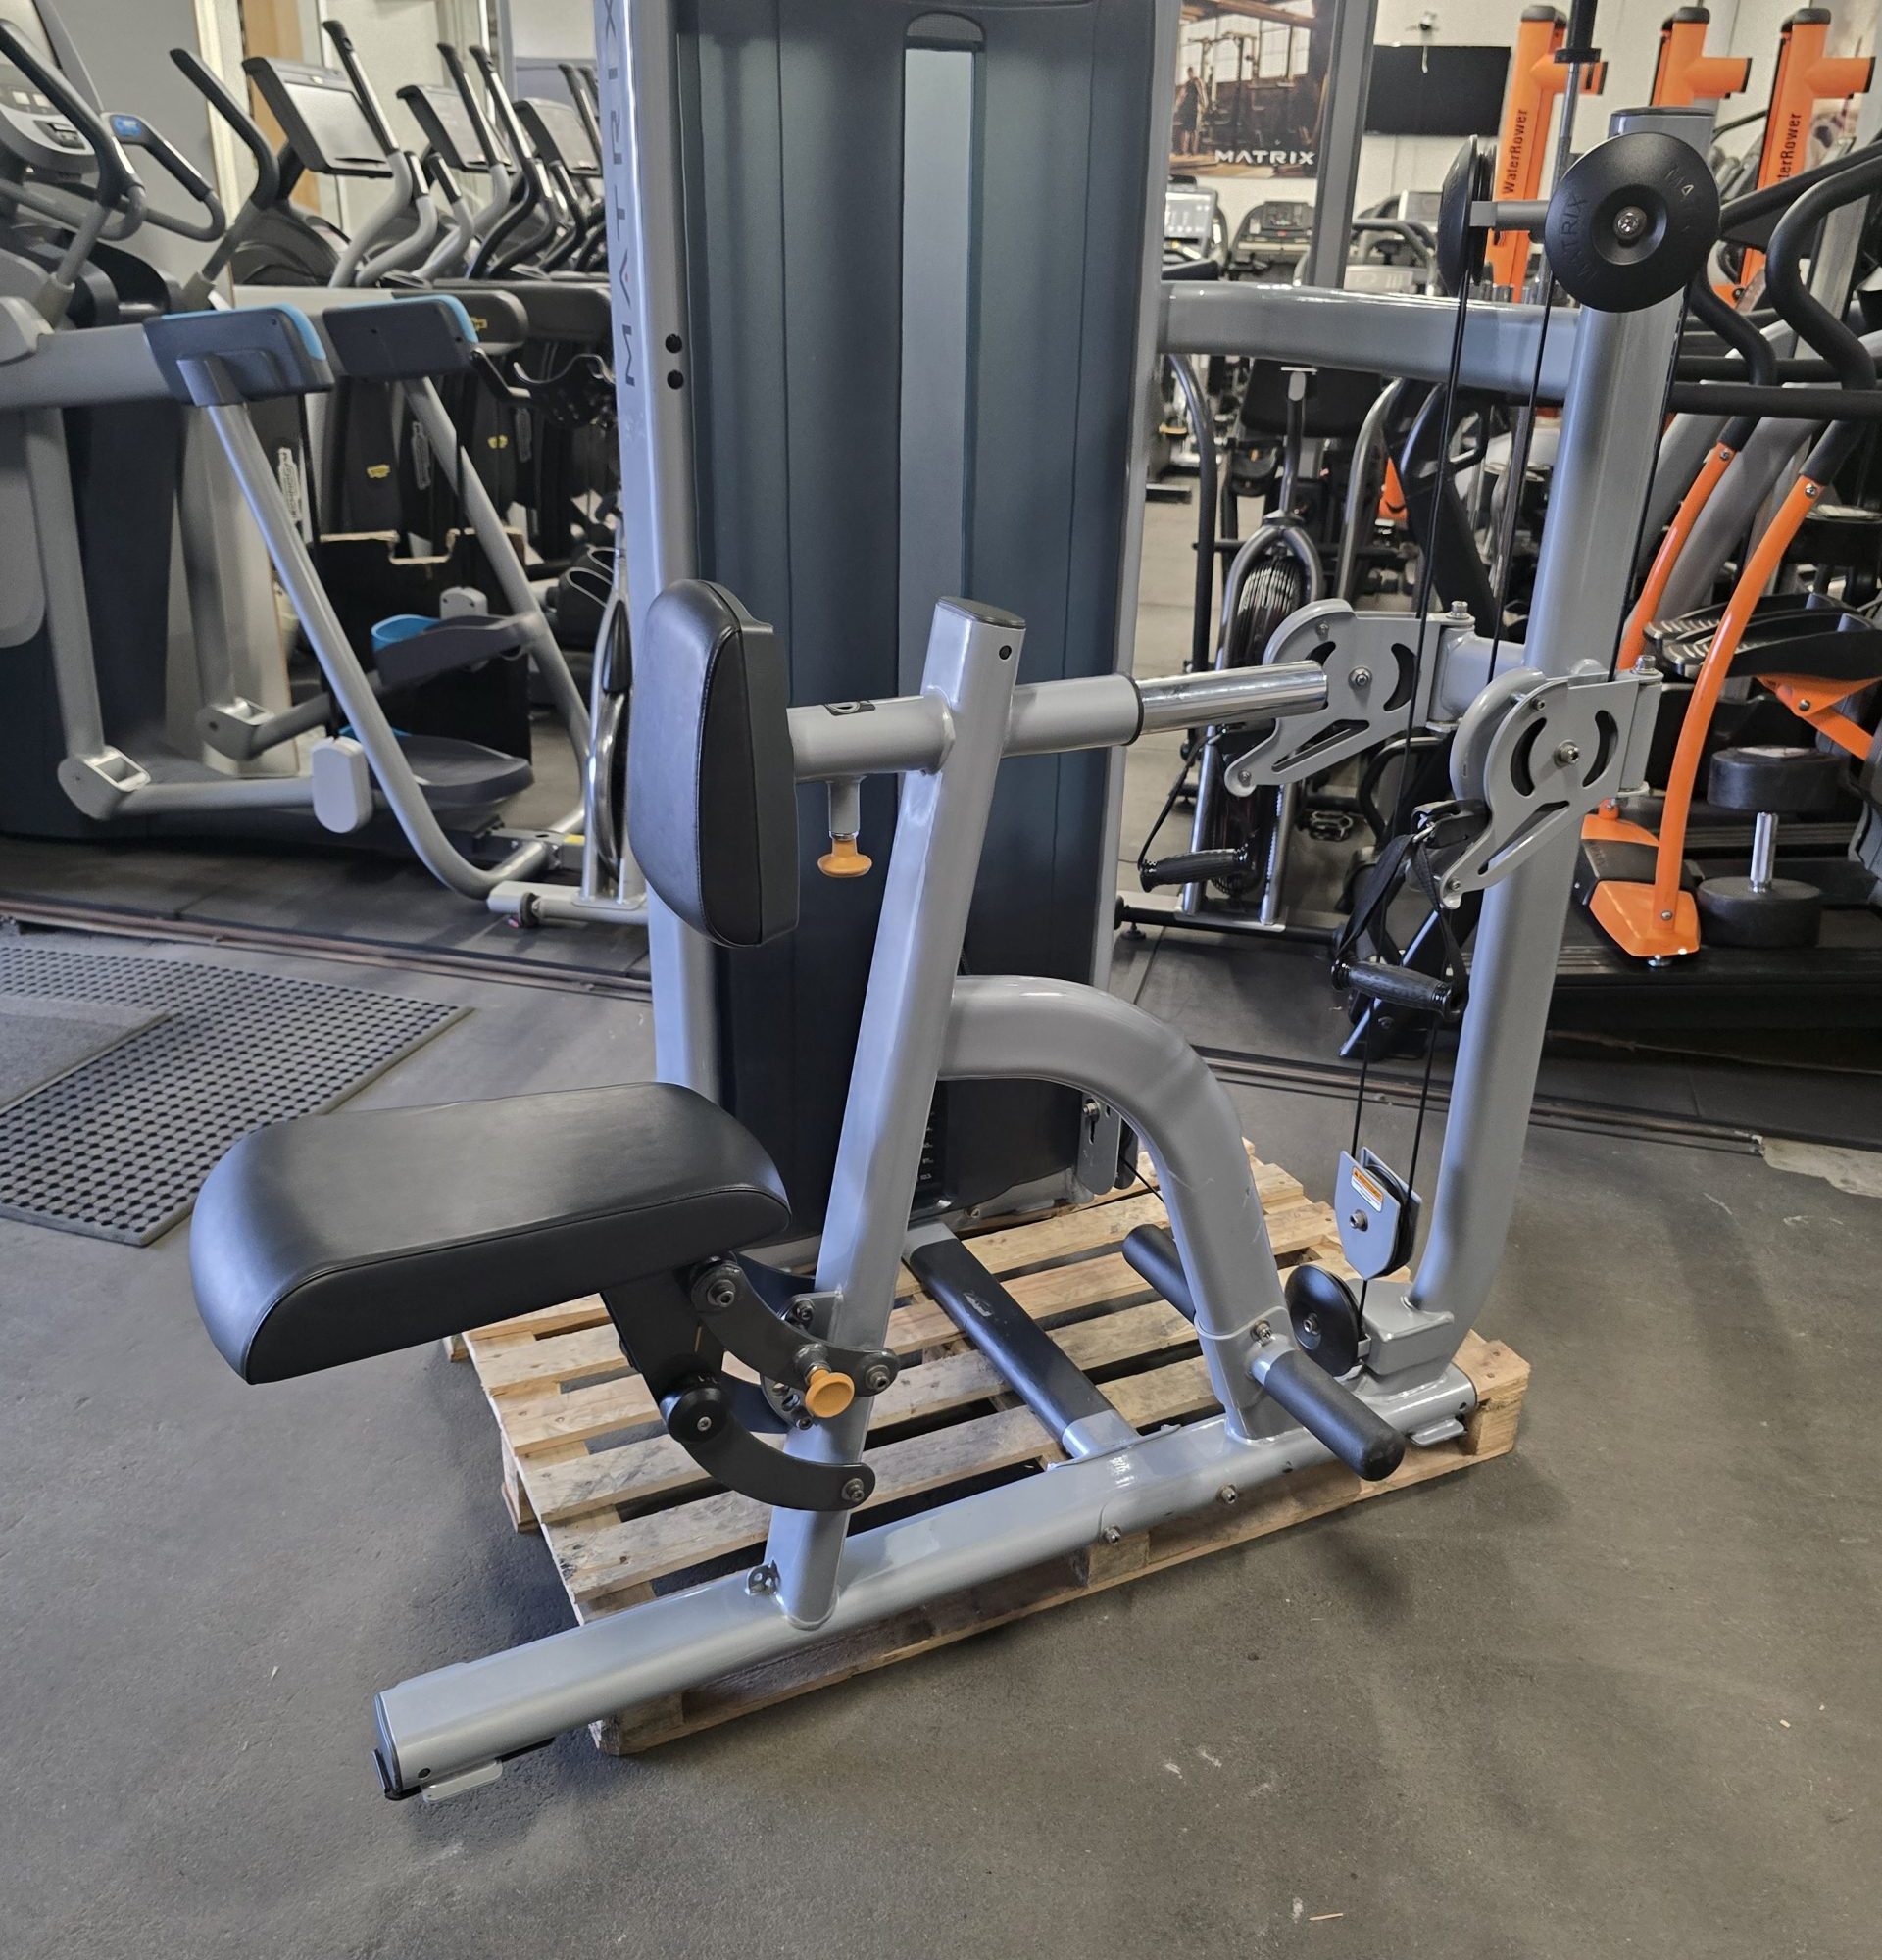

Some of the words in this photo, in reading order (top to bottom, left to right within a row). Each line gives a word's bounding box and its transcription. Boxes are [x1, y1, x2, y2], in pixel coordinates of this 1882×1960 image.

[1214, 149, 1315, 165] MATRIX
[1502, 109, 1527, 195] WaterRower
[1776, 112, 1802, 179] terRower
[604, 0, 635, 388] MATRIX
